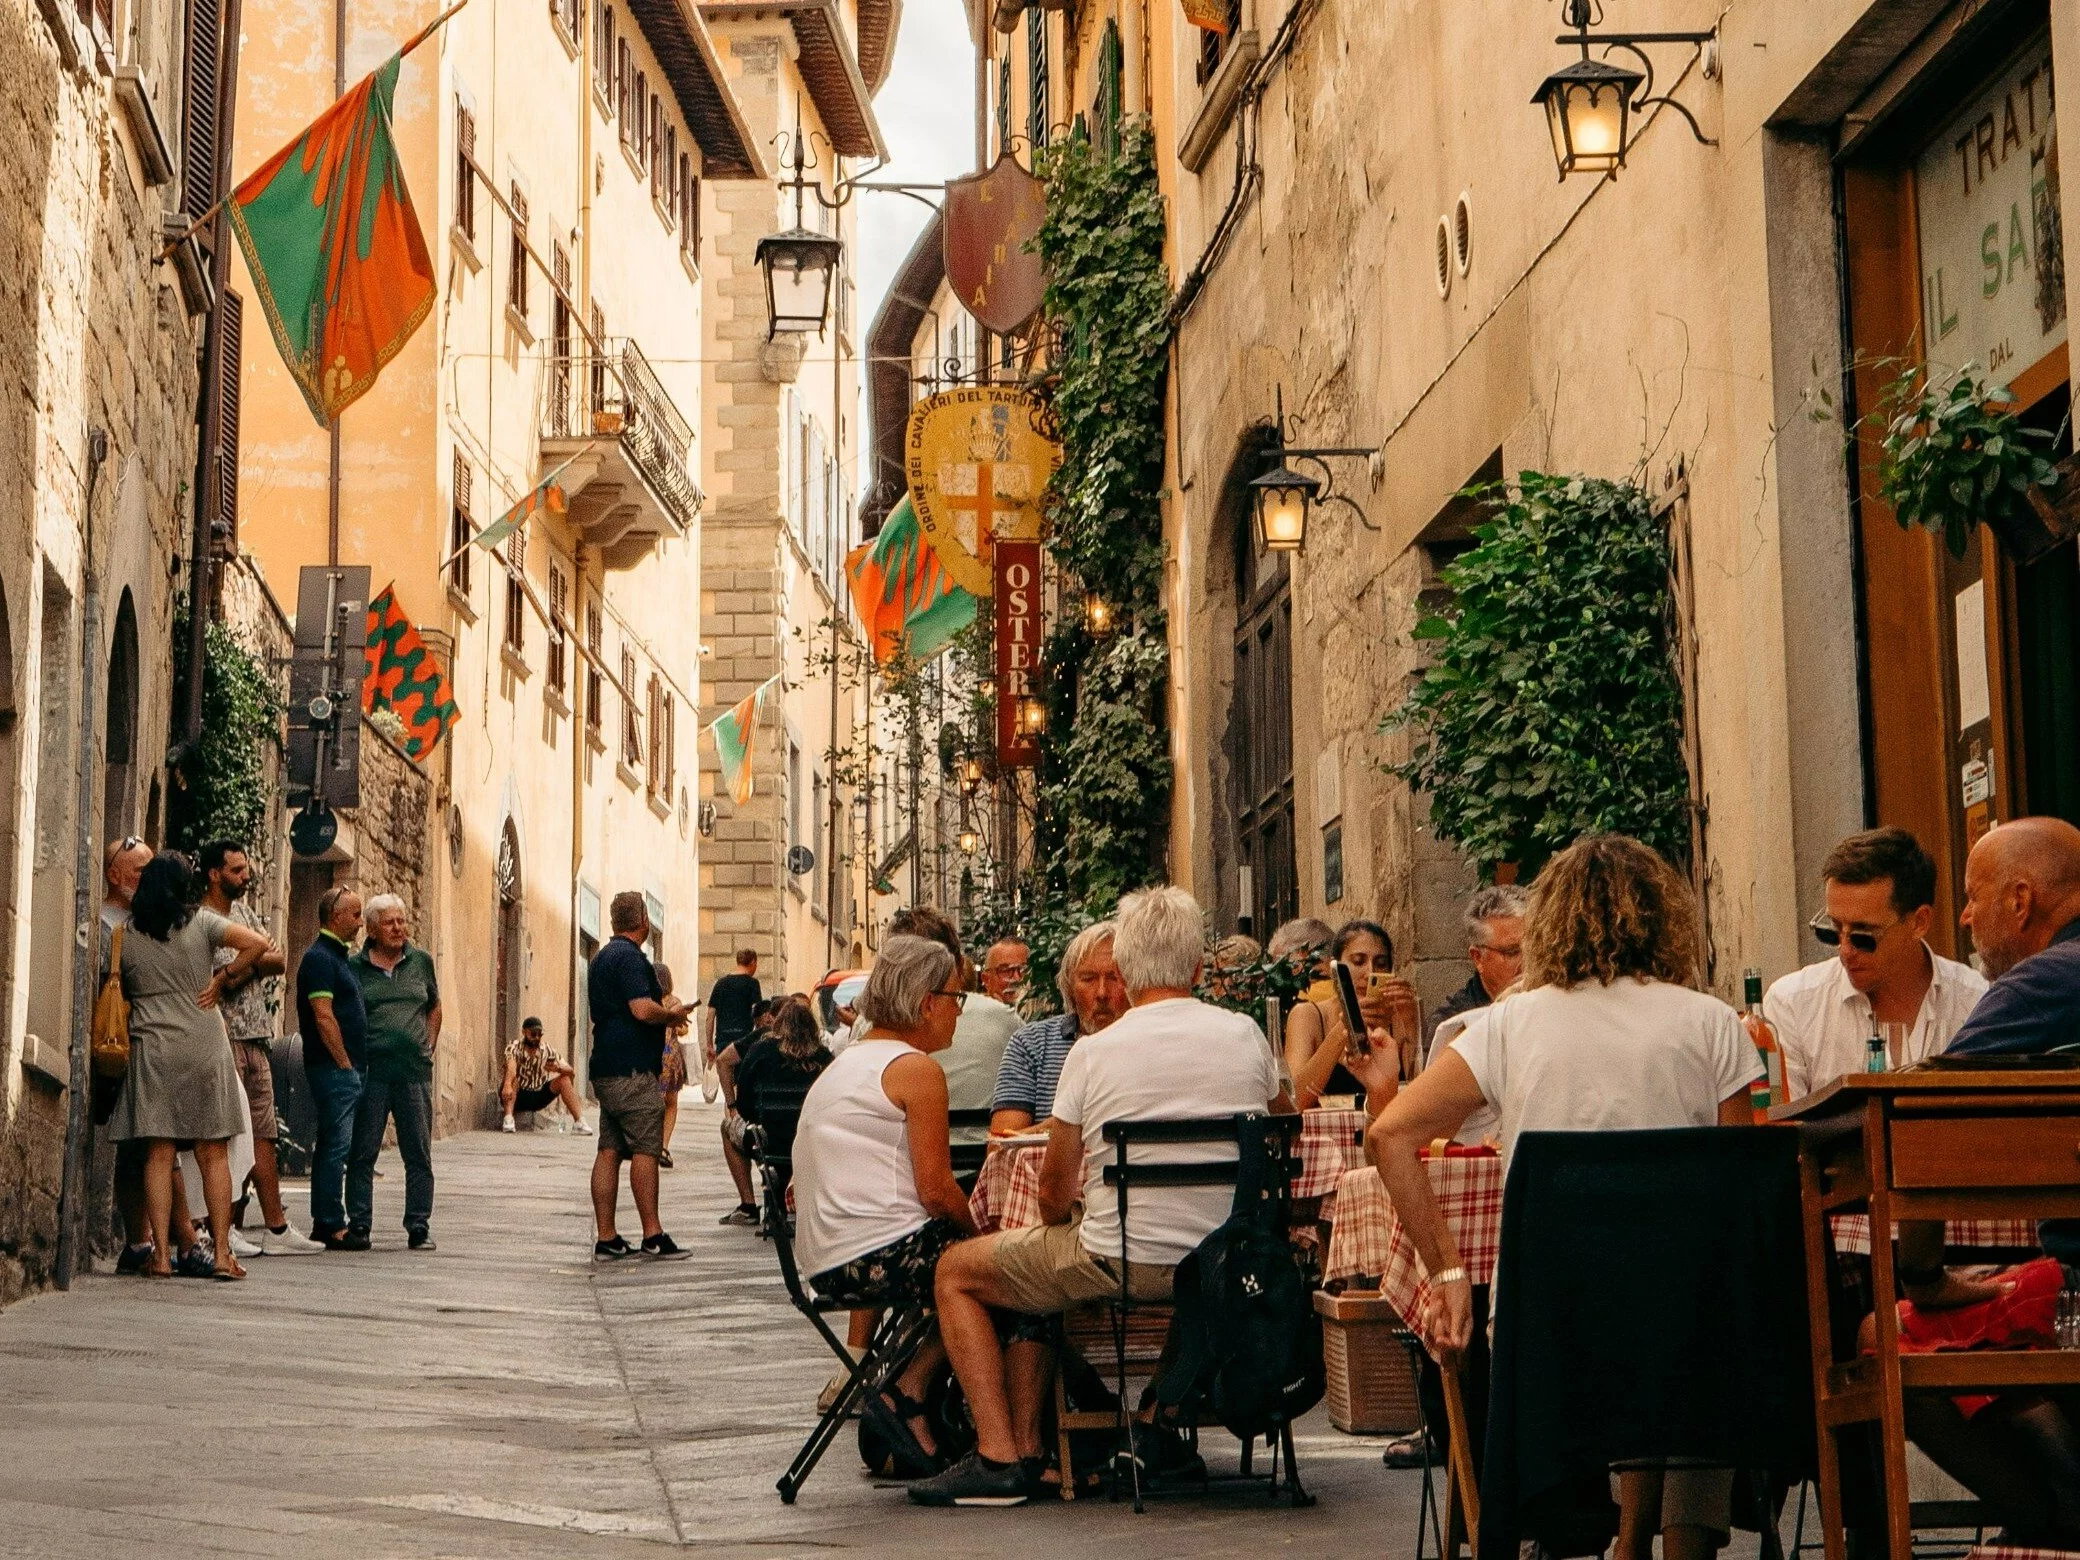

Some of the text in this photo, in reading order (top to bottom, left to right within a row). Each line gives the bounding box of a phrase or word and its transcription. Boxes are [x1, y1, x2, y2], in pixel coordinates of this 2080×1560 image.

[1928, 267, 1959, 348] IL
[1990, 338, 2015, 372] DAL
[957, 391, 982, 403] DEL
[911, 395, 951, 449] CAVALIERI
[911, 456, 923, 478] DEI
[913, 484, 937, 533] ORDINE
